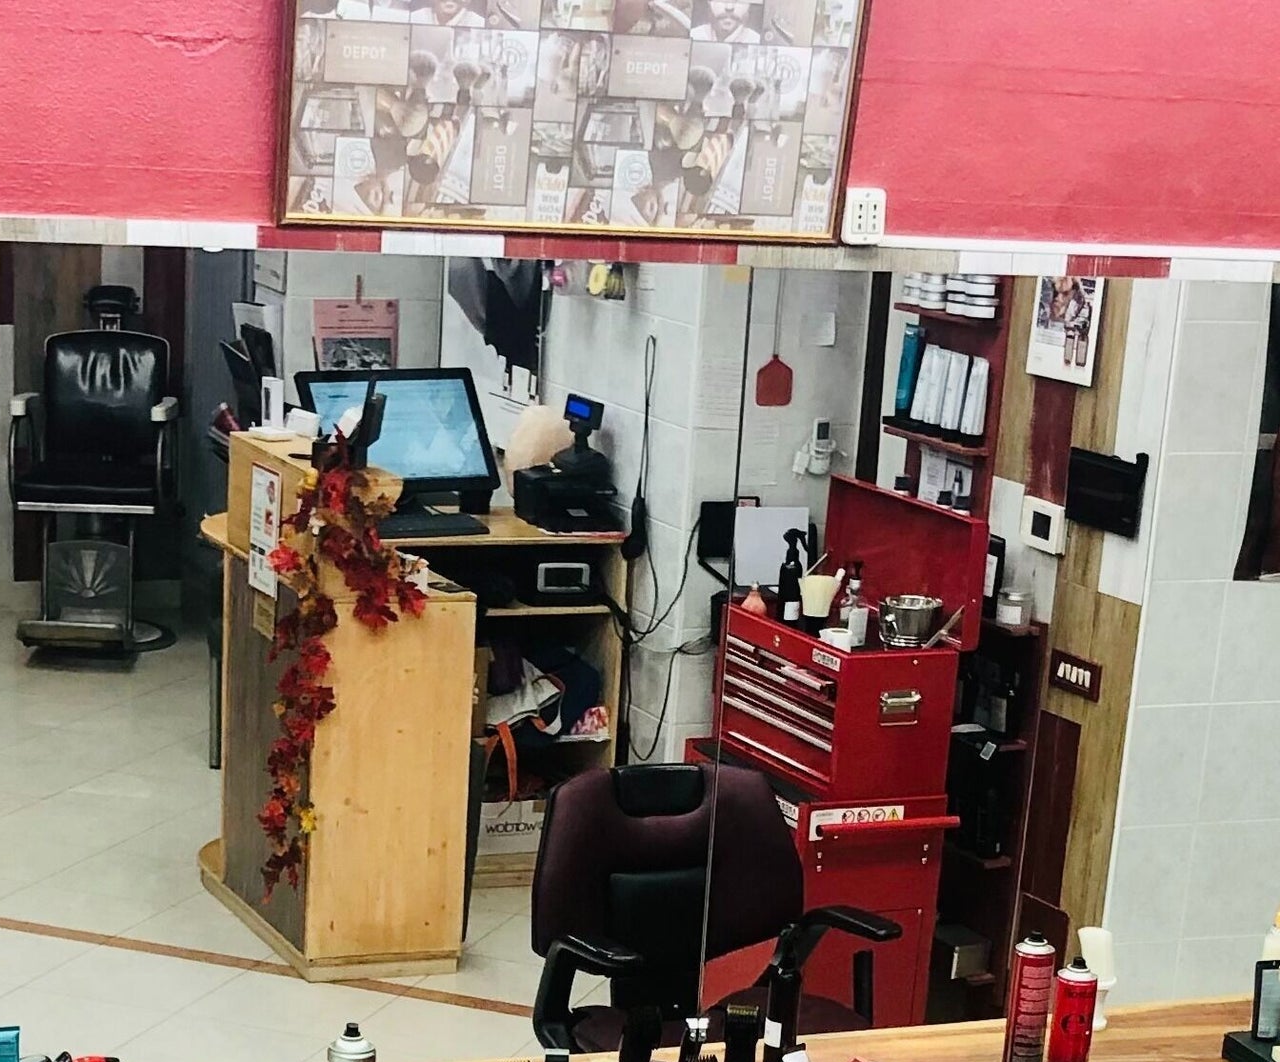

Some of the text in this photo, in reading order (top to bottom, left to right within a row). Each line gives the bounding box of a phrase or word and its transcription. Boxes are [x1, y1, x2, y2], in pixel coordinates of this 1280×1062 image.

[343, 46, 386, 60] DEPOT
[626, 61, 669, 75] DEPOT
[493, 145, 507, 192] DEPOT
[761, 157, 777, 202] DEPOT
